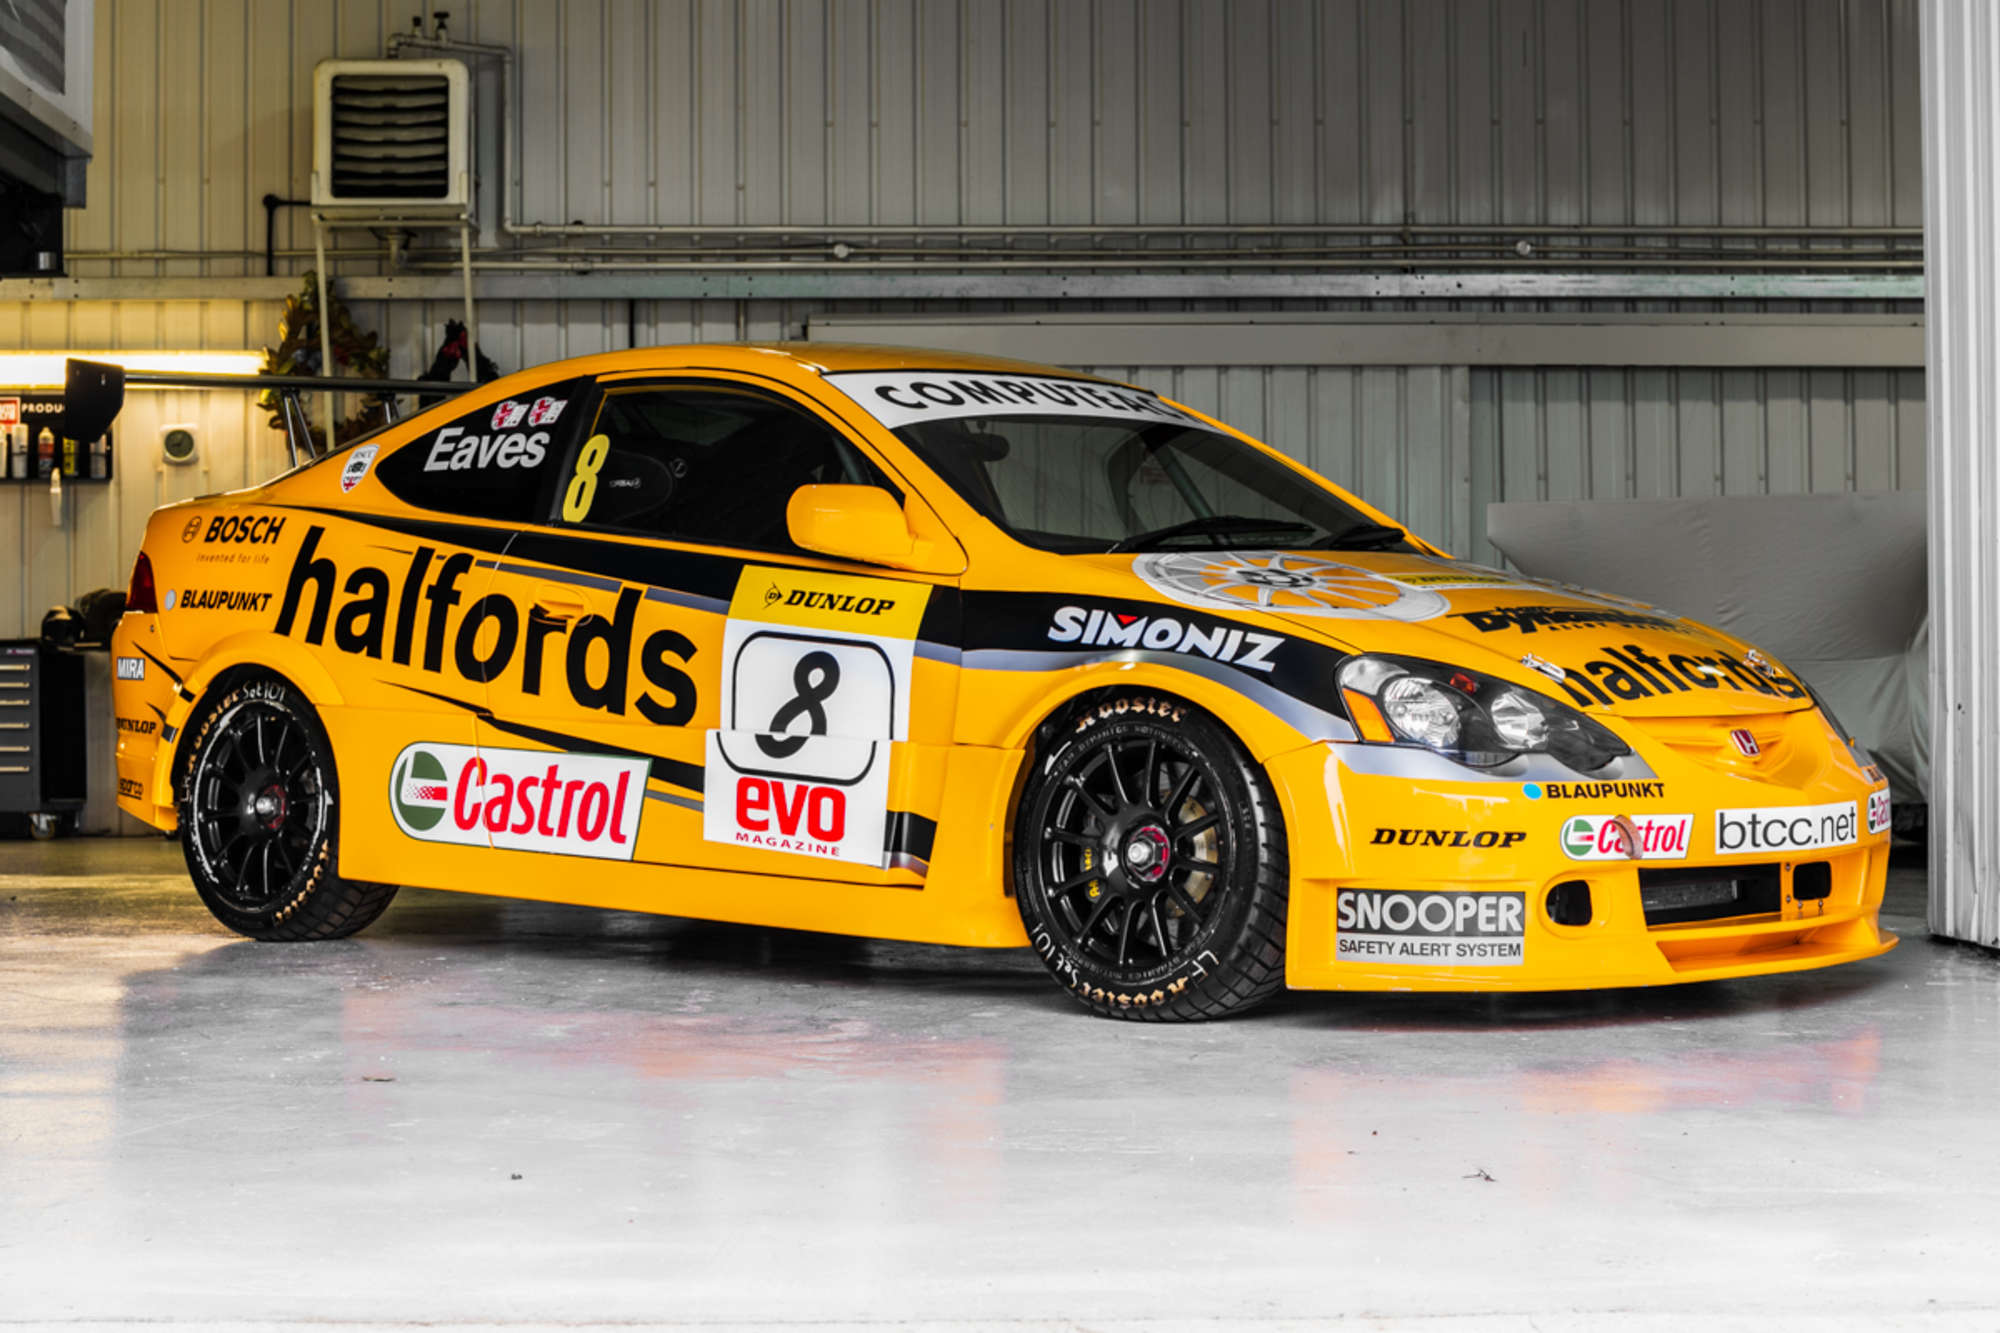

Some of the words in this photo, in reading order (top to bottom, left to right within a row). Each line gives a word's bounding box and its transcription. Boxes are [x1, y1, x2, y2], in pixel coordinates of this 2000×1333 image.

[21, 403, 65, 413] PRODU
[424, 426, 550, 472] Eaves
[562, 434, 610, 523] 8
[204, 515, 287, 544] BOSCH
[180, 589, 273, 612] BLAUPUNKT
[784, 589, 896, 616] DUNLOP
[273, 525, 698, 727] halfords
[1048, 606, 1286, 672] SIMONIZ
[117, 658, 145, 680] MIRA
[754, 650, 841, 759] 8
[116, 717, 157, 734] DUNLOP
[454, 756, 631, 844] Castrol
[1546, 782, 1665, 799] BLAUPUNKT
[736, 776, 846, 842] evo
[1370, 828, 1527, 848] DUNLOP
[1719, 806, 1857, 850] btcc.net
[736, 831, 841, 857] MAGAZINE
[1337, 892, 1523, 932] SNOOPER
[1339, 939, 1395, 957] SAFETY
[1399, 941, 1452, 958] ALERT
[1456, 942, 1521, 958] SYSTEM
